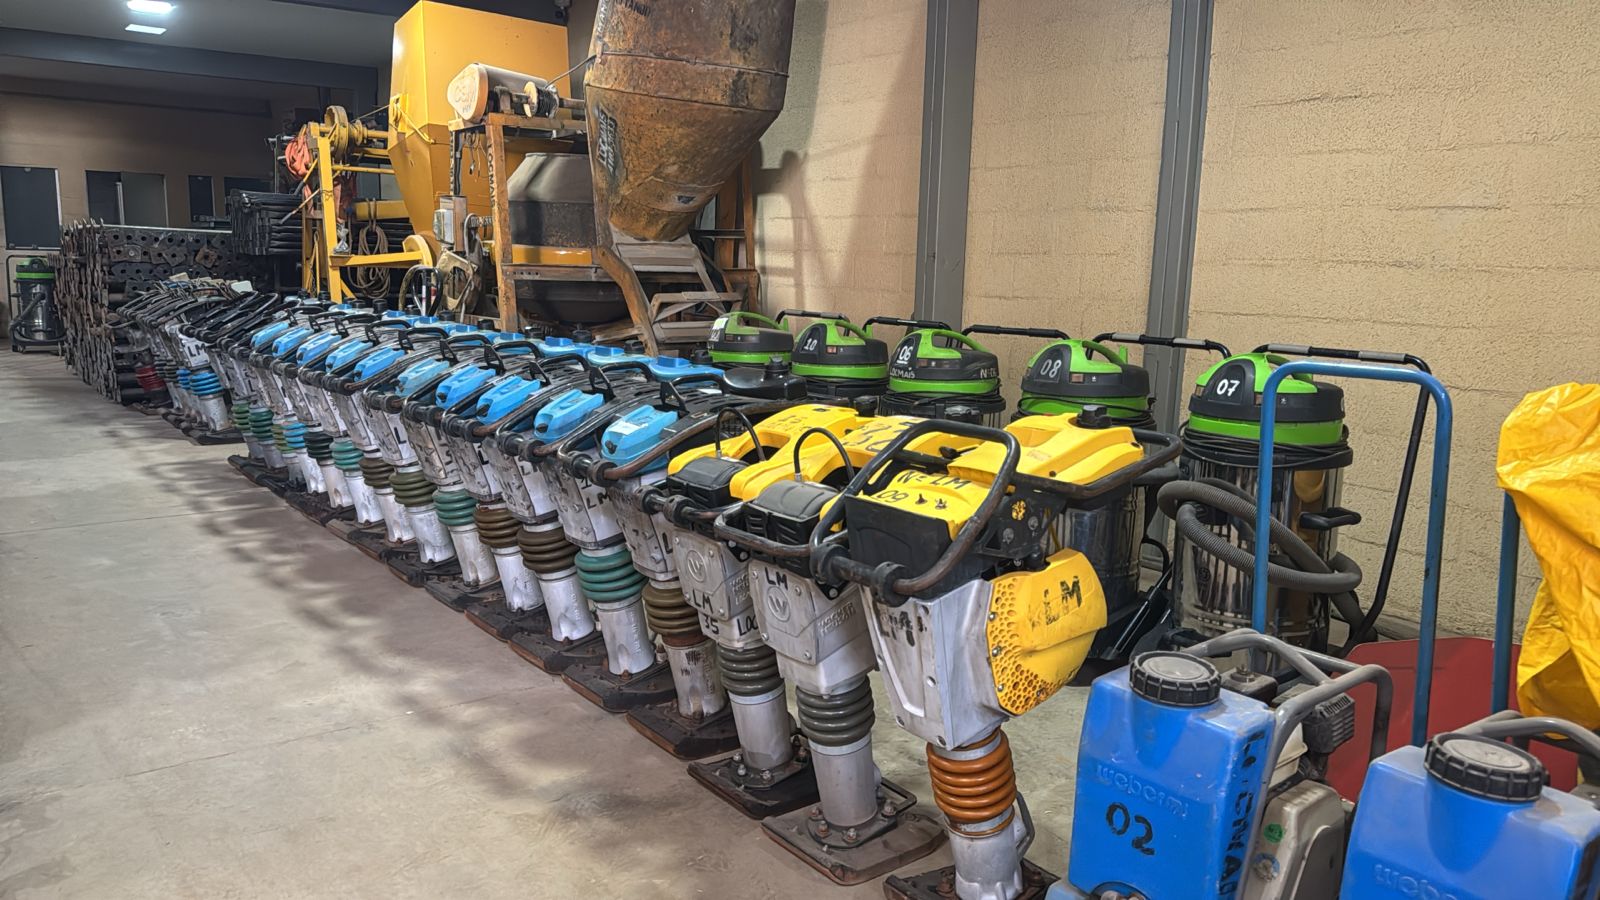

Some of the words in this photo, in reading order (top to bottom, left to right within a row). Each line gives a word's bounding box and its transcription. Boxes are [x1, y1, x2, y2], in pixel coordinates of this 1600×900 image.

[803, 338, 818, 351] 10
[898, 345, 914, 361] 06
[1040, 359, 1062, 378] 08
[1216, 378, 1241, 397] 07
[931, 477, 972, 490] LM
[764, 566, 789, 591] LM
[692, 588, 714, 614] LM
[1105, 801, 1155, 856] 02
